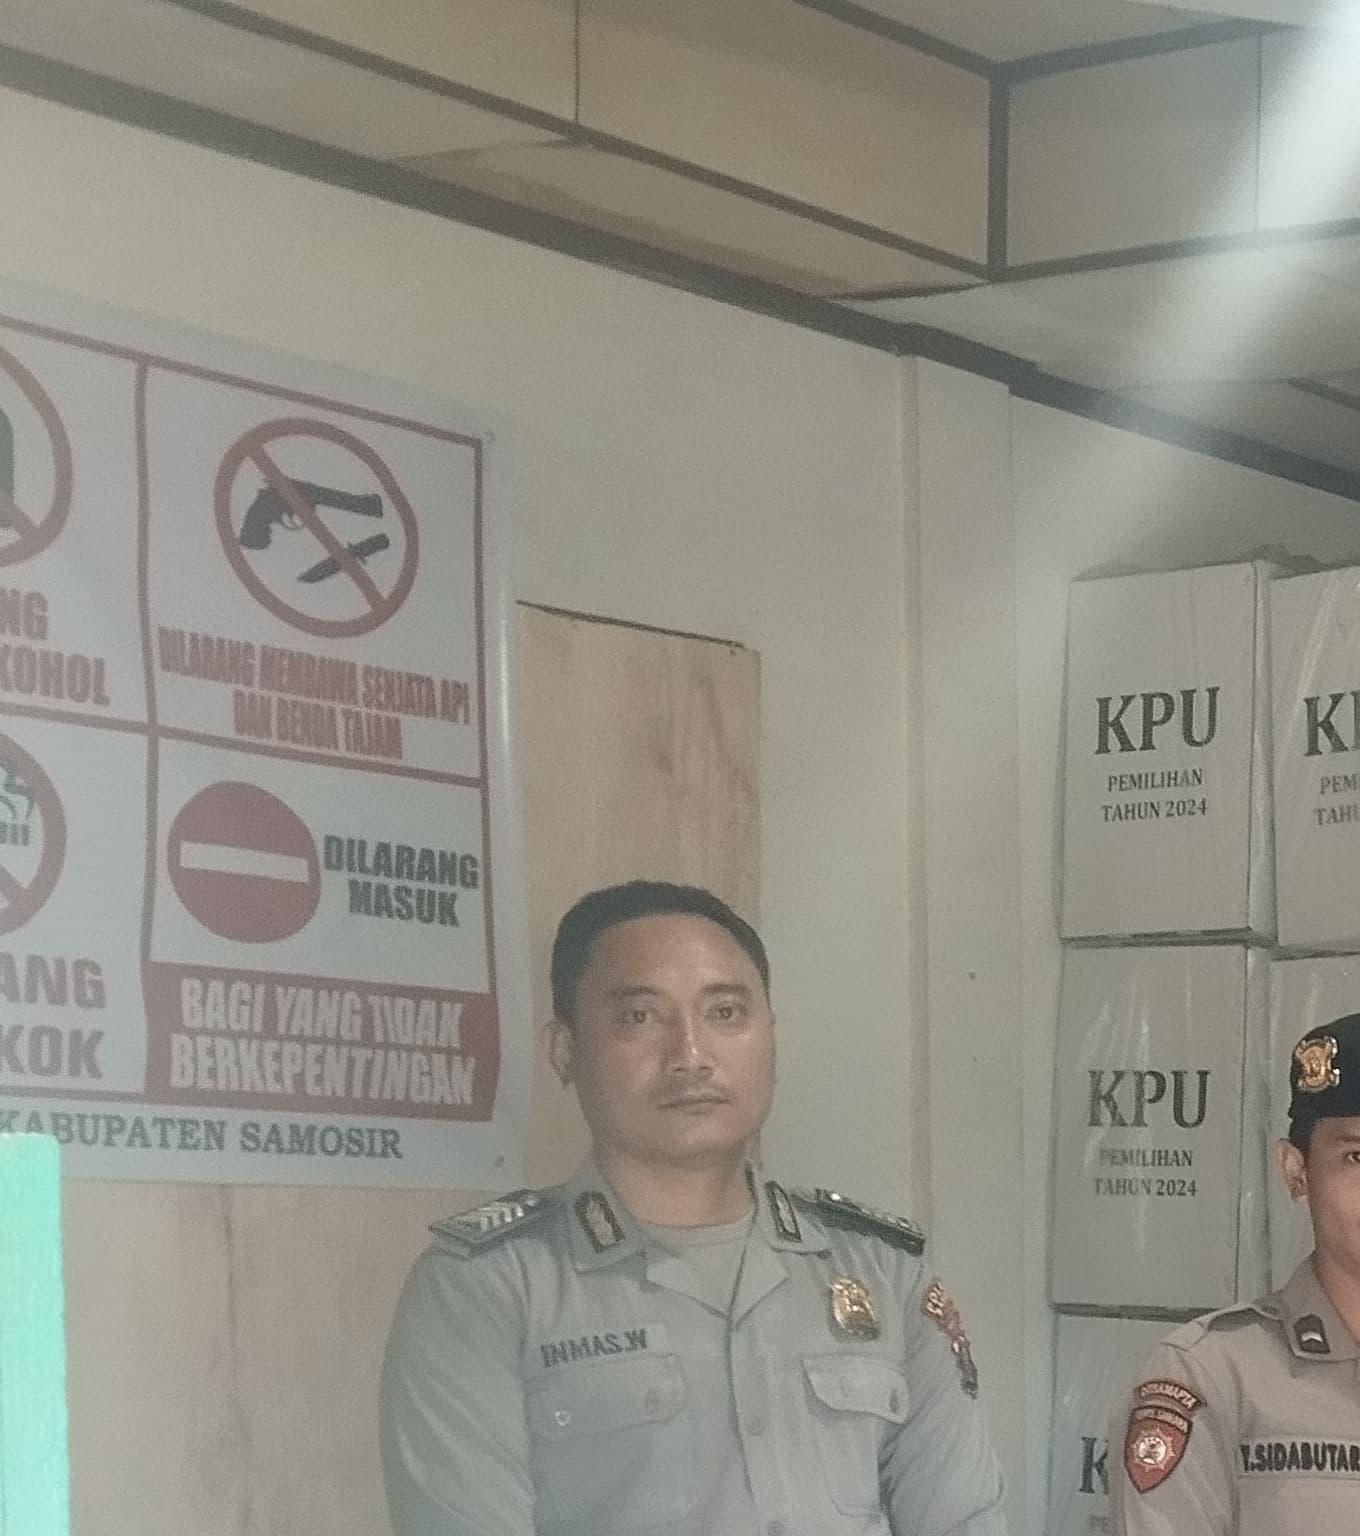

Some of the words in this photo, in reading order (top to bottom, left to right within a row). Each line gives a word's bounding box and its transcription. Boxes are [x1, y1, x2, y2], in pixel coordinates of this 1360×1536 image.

[1094, 686, 1220, 755] KPU
[1108, 768, 1203, 792] PEMILIHAN
[1101, 801, 1160, 823] TAHUN
[1166, 798, 1208, 817] 2024
[323, 834, 479, 889] DILARANG
[348, 879, 460, 927] MASUK
[180, 977, 266, 1033] BAGI
[274, 984, 362, 1042] YANG
[367, 994, 463, 1048] TIDAK
[168, 1032, 477, 1105] BERKEPENTINGAN
[1088, 1070, 1210, 1128] KPU
[240, 1121, 403, 1159] SAMOSIR
[1100, 1149, 1193, 1168] PEMILIHAN
[1156, 1179, 1197, 1197] 2024
